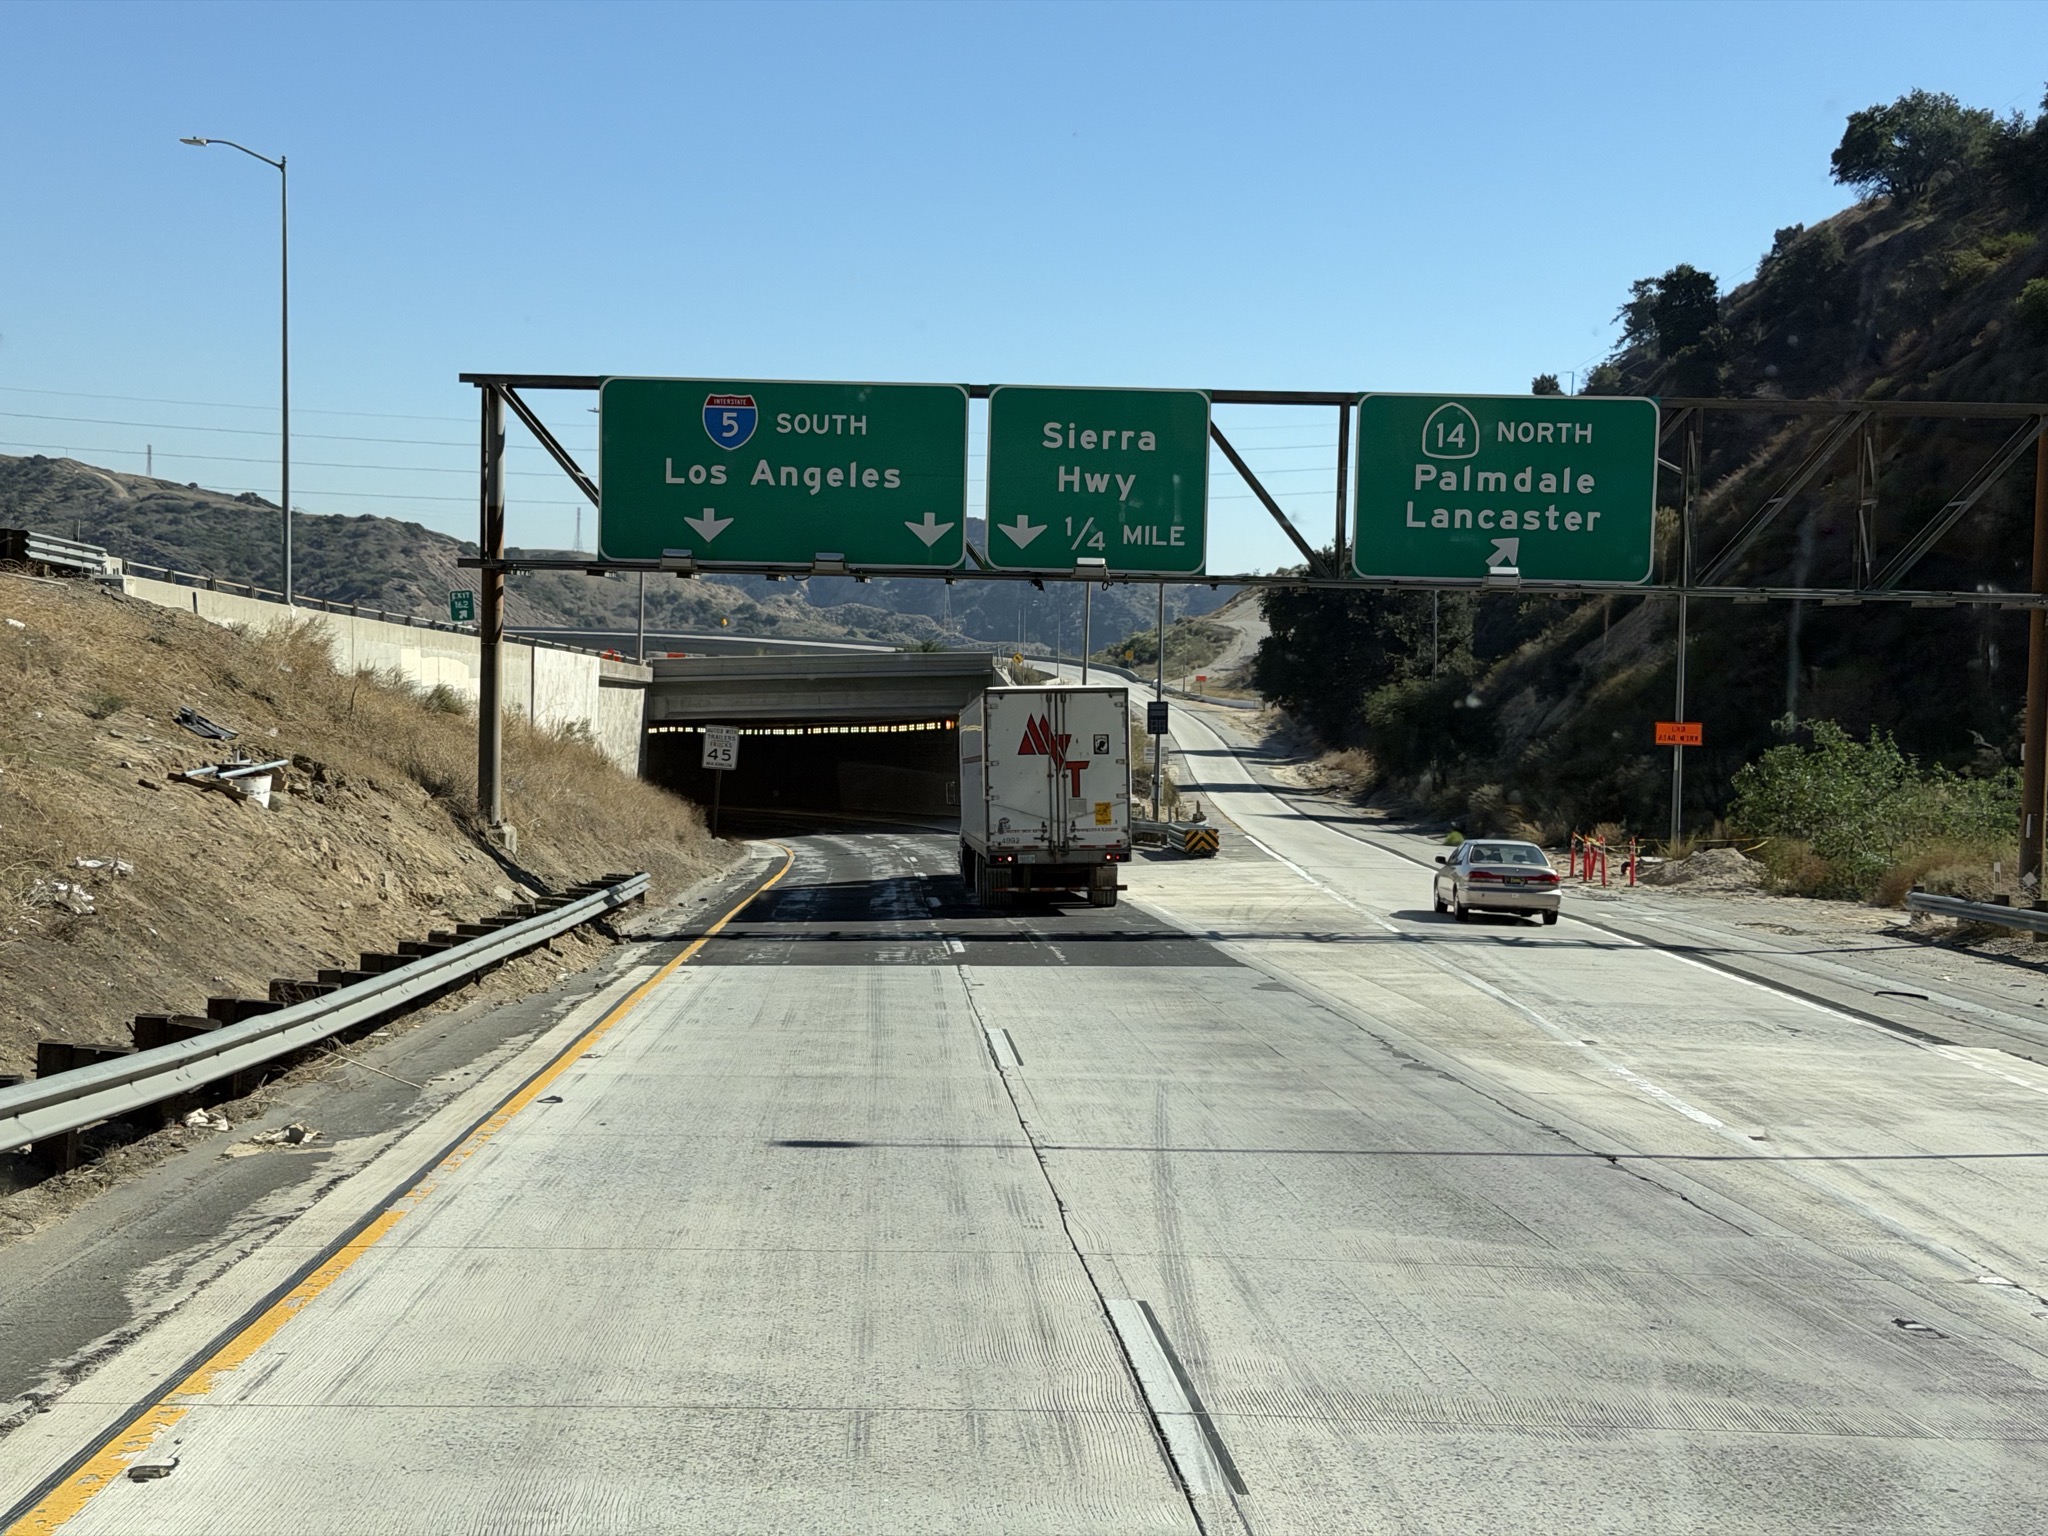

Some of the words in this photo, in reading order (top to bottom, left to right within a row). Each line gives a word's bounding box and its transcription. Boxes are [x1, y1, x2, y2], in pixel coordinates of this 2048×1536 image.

[713, 398, 748, 406] INTERSTATE
[722, 412, 739, 437] 5
[776, 413, 867, 435] SOUTH
[1042, 422, 1156, 451] Sierra
[1436, 423, 1466, 448] 14
[1498, 421, 1592, 444] NORTH
[665, 457, 727, 485] Los
[751, 459, 901, 496] Angeles
[1058, 465, 1136, 501] Hwy
[1414, 464, 1595, 494] Palmdale
[1406, 501, 1601, 532] Lancaster
[1065, 516, 1105, 551] 1/4
[1123, 525, 1185, 546] MILE
[452, 592, 470, 600] EXIT
[707, 748, 731, 761] 45
